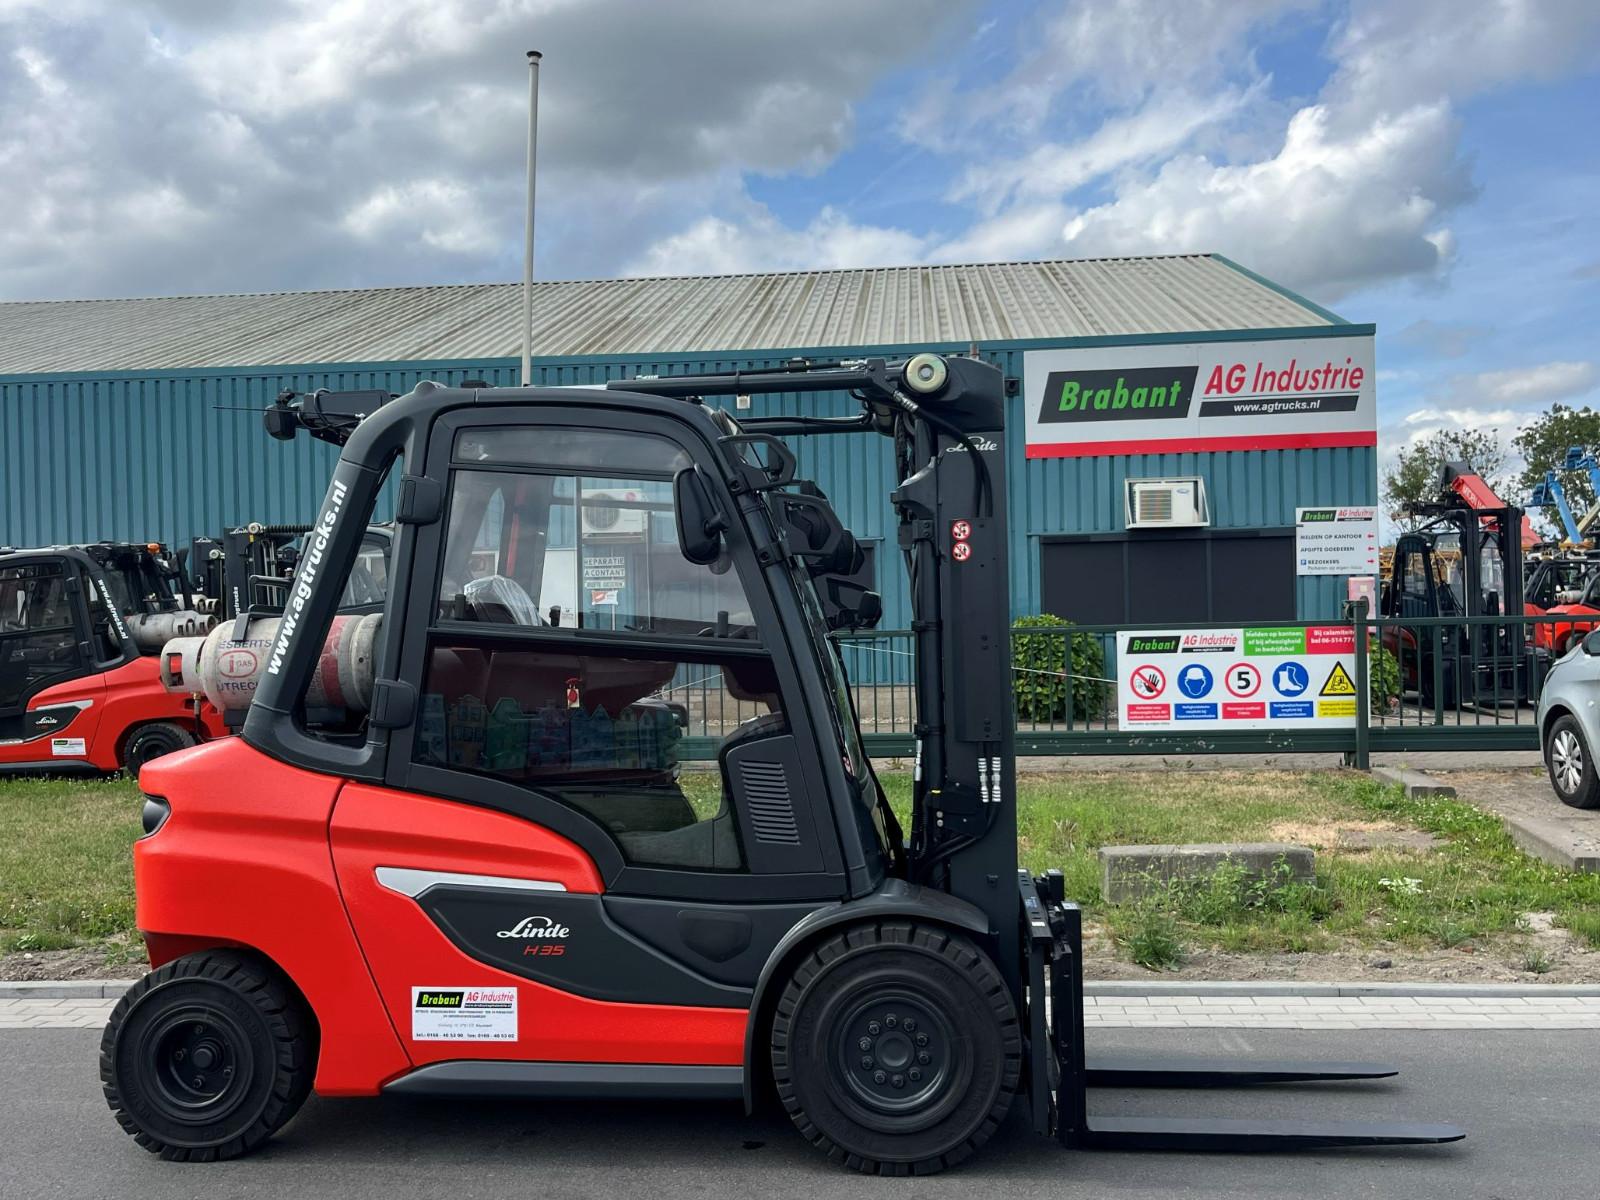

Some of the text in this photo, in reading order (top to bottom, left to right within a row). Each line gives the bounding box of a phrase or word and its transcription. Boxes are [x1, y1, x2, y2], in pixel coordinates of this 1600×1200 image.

[1058, 357, 1364, 412] Brabant AG Industrie
[1233, 400, 1321, 414] www.agtrucks.nl
[1304, 512, 1333, 521] Brabant
[268, 479, 348, 676] www.agtrucks.nl
[1132, 633, 1238, 651] Brabant AG Industrie
[216, 681, 259, 692] UTREC
[1237, 671, 1251, 690] 5
[496, 916, 570, 938] Linde
[421, 991, 515, 1005] Brabant AG Industrie
